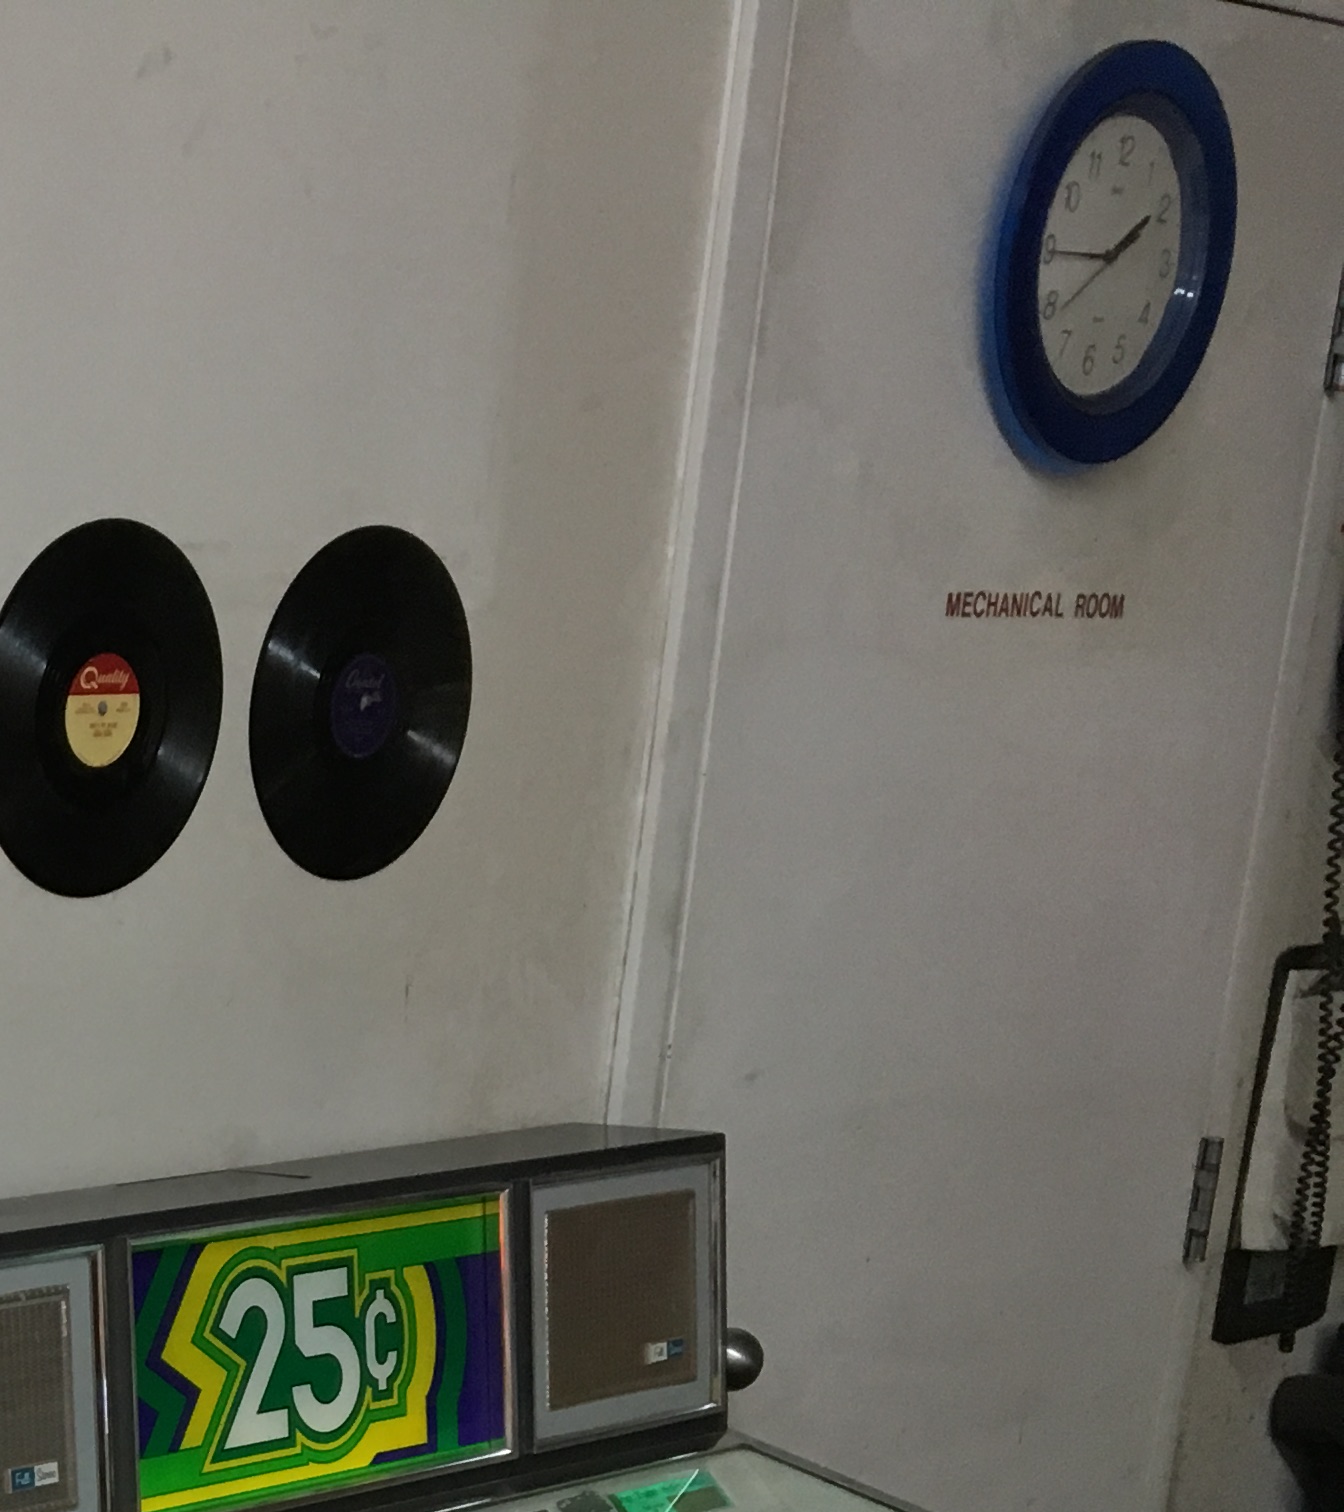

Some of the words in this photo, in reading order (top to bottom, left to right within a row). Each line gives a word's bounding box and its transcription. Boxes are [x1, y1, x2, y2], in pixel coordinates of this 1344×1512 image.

[945, 589, 1065, 620] MECHANICAL
[1073, 592, 1126, 620] ROOM
[80, 666, 130, 691] Quality
[217, 1262, 400, 1451] 25¢
